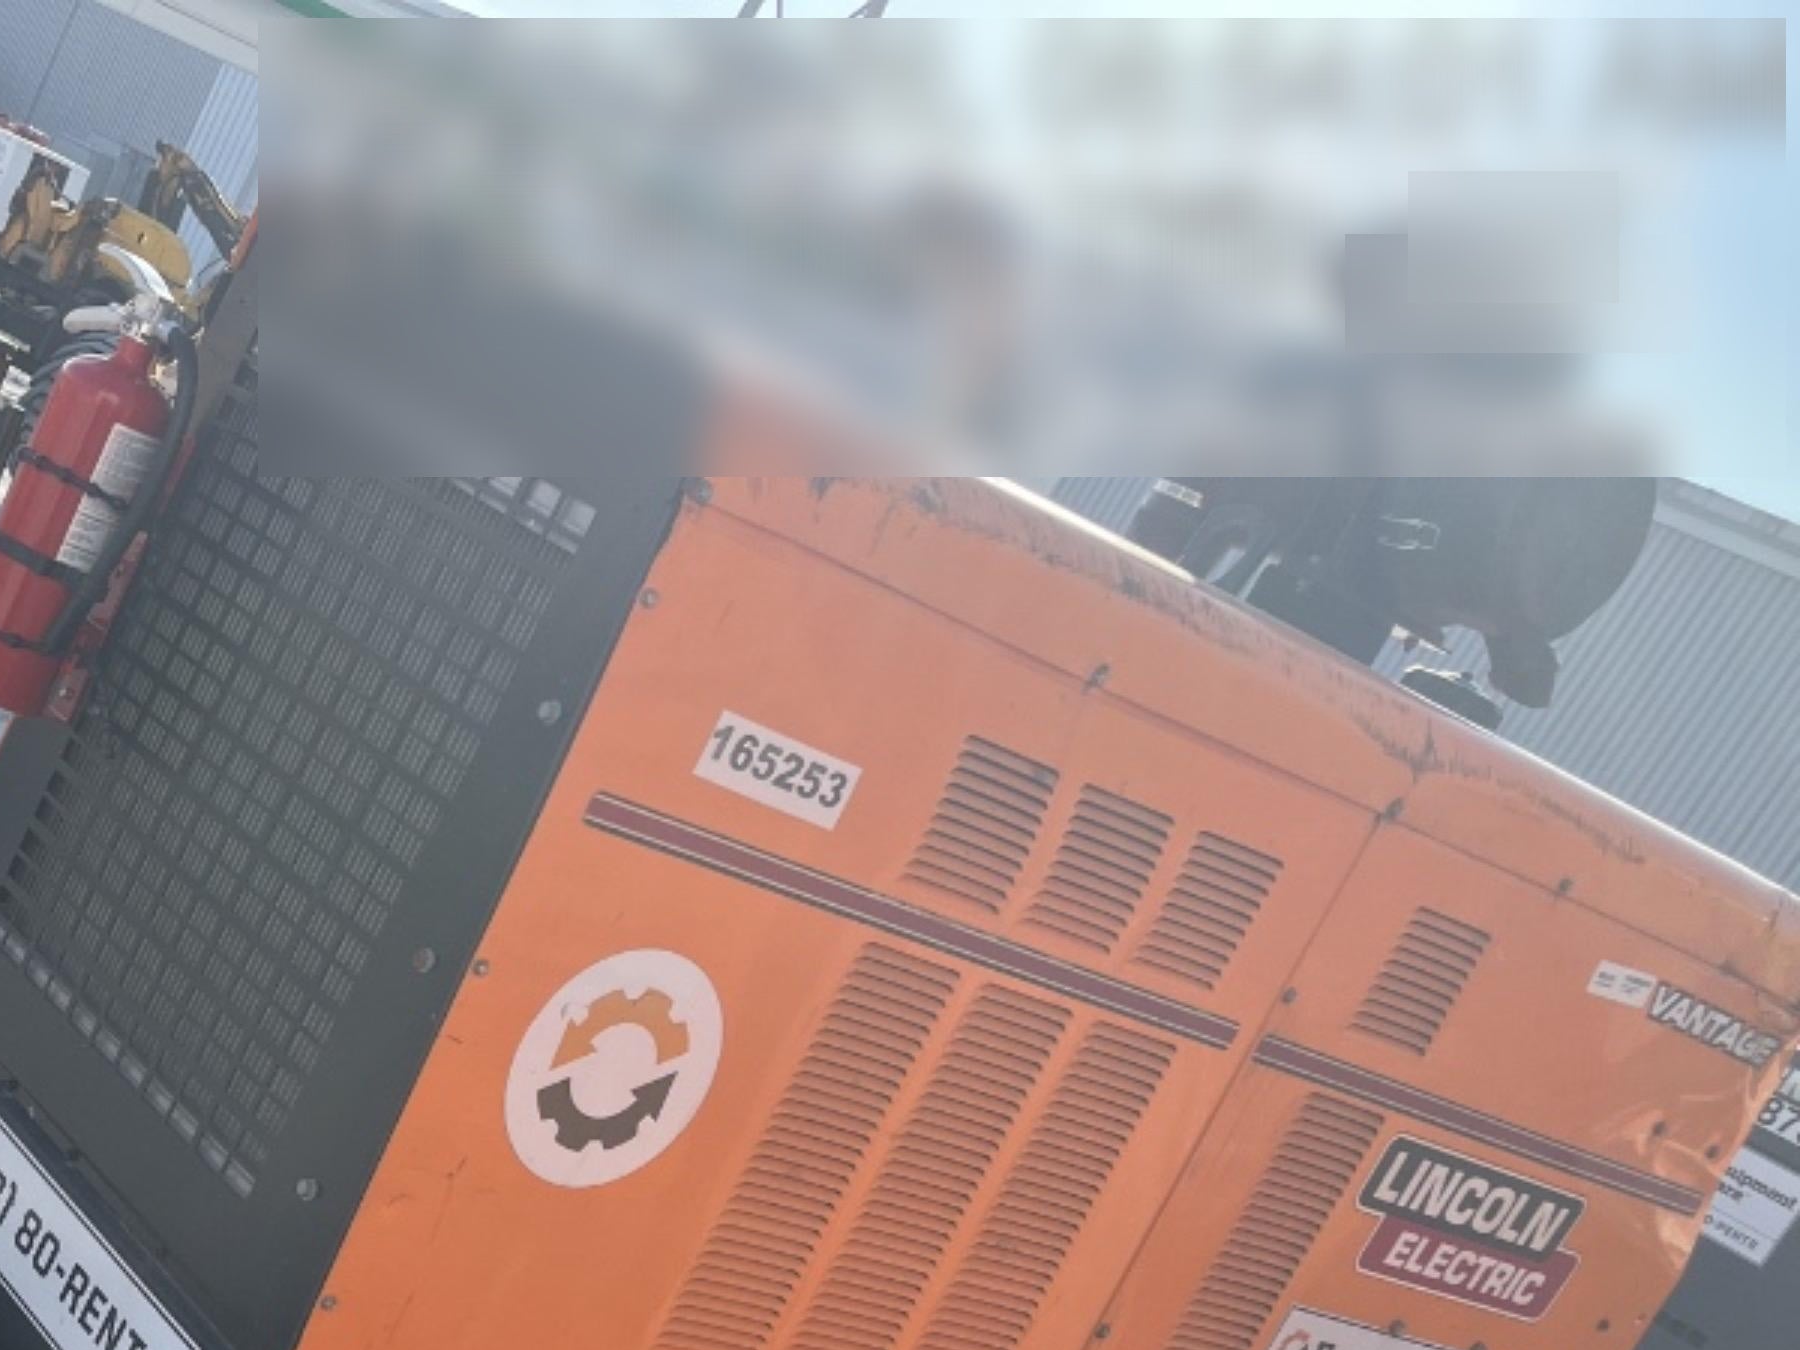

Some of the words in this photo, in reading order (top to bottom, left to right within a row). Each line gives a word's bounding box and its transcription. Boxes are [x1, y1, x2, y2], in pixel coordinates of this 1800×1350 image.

[711, 725, 848, 808] 165253
[1651, 985, 1781, 1066] VANTAGE
[1373, 1151, 1570, 1252] LINCOLN
[1382, 1231, 1546, 1306] ELECTRIC
